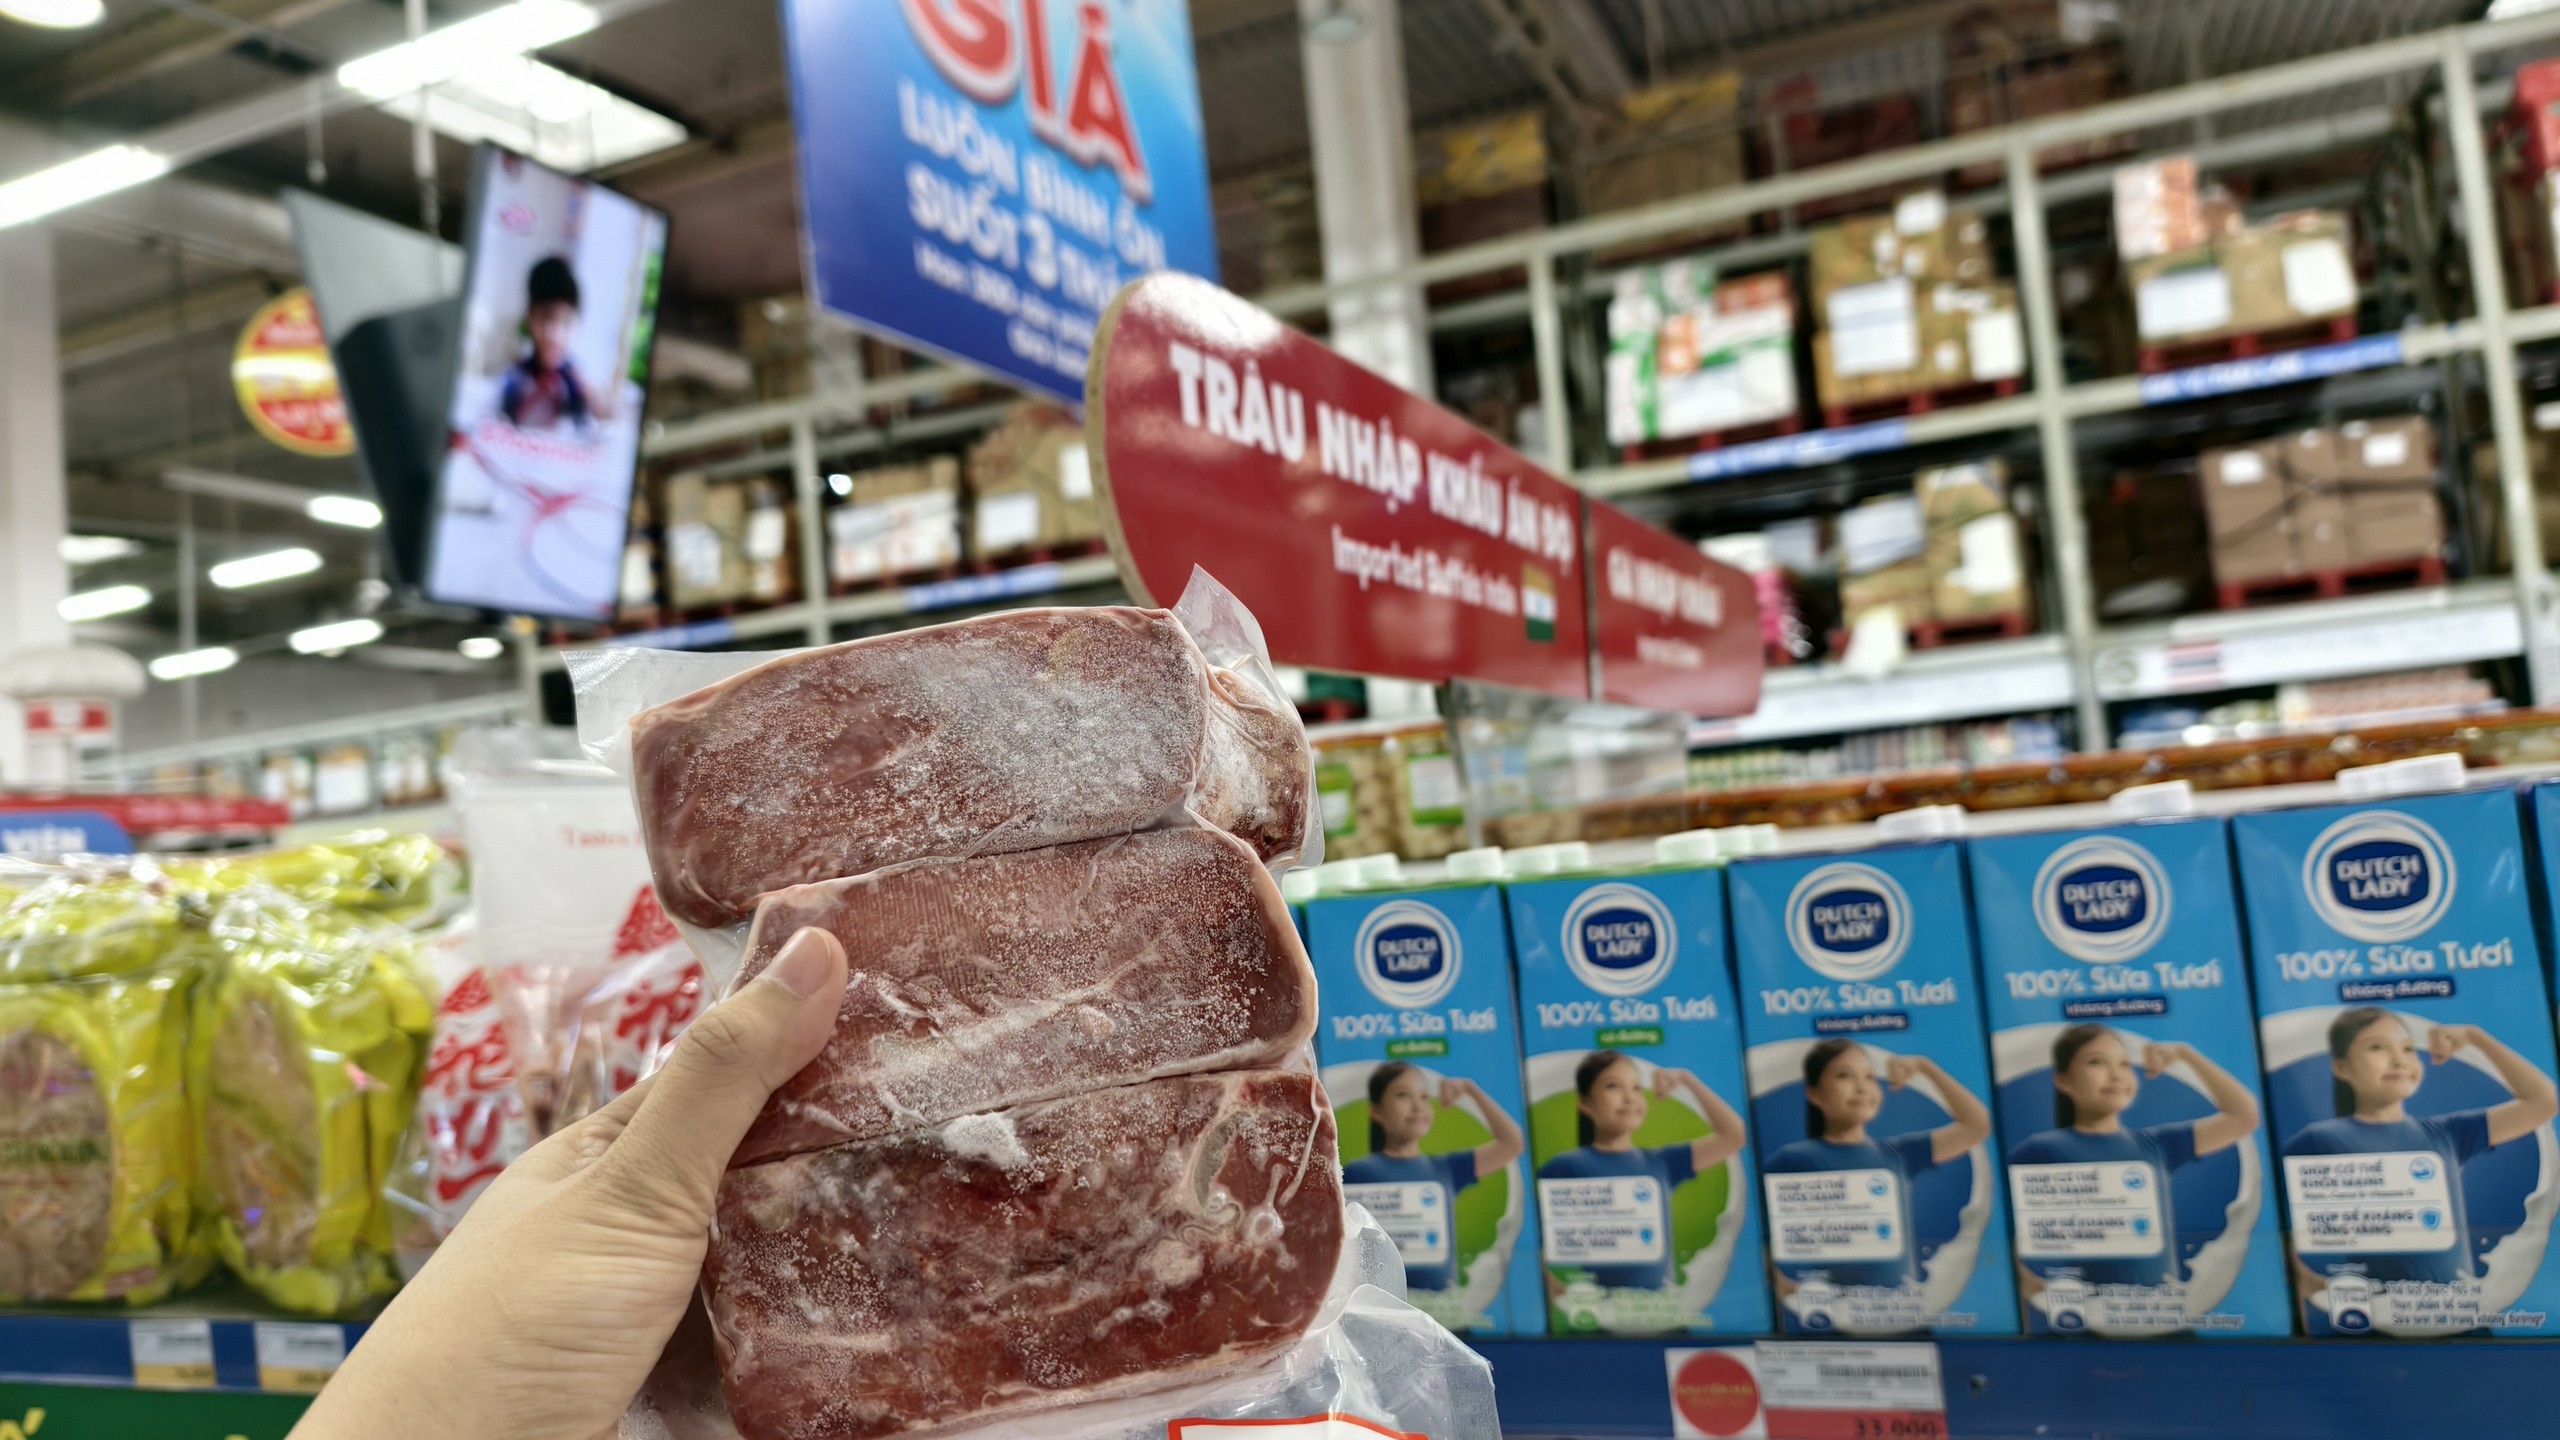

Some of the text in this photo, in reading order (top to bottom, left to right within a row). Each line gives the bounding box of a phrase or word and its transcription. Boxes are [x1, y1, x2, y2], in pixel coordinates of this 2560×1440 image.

[1169, 340, 1306, 463] TRÂU
[1316, 402, 1423, 514] NHẬP
[1331, 523, 1423, 591] Imported
[2336, 854, 2423, 883] DUTCH
[2063, 879, 2141, 904] DUTCH
[2349, 876, 2413, 901] LADY
[1812, 902, 1884, 926] DUTCH
[2073, 901, 2133, 923] LADY
[1586, 920, 1651, 942] DUTCH
[1823, 922, 1876, 943] LADY
[1377, 936, 1438, 958] DUTCH
[1595, 939, 1644, 960] LADY
[2275, 936, 2515, 982] 100% Sữa Tươi
[1386, 954, 1433, 974] LADY
[2004, 957, 2224, 999] 100% Sữa Tươi
[1760, 977, 1958, 1016] 100% Sữa Tươi
[1332, 1006, 1498, 1040] 100% Sữa Tươi
[1537, 993, 1719, 1029] 100% Sữa Tươi
